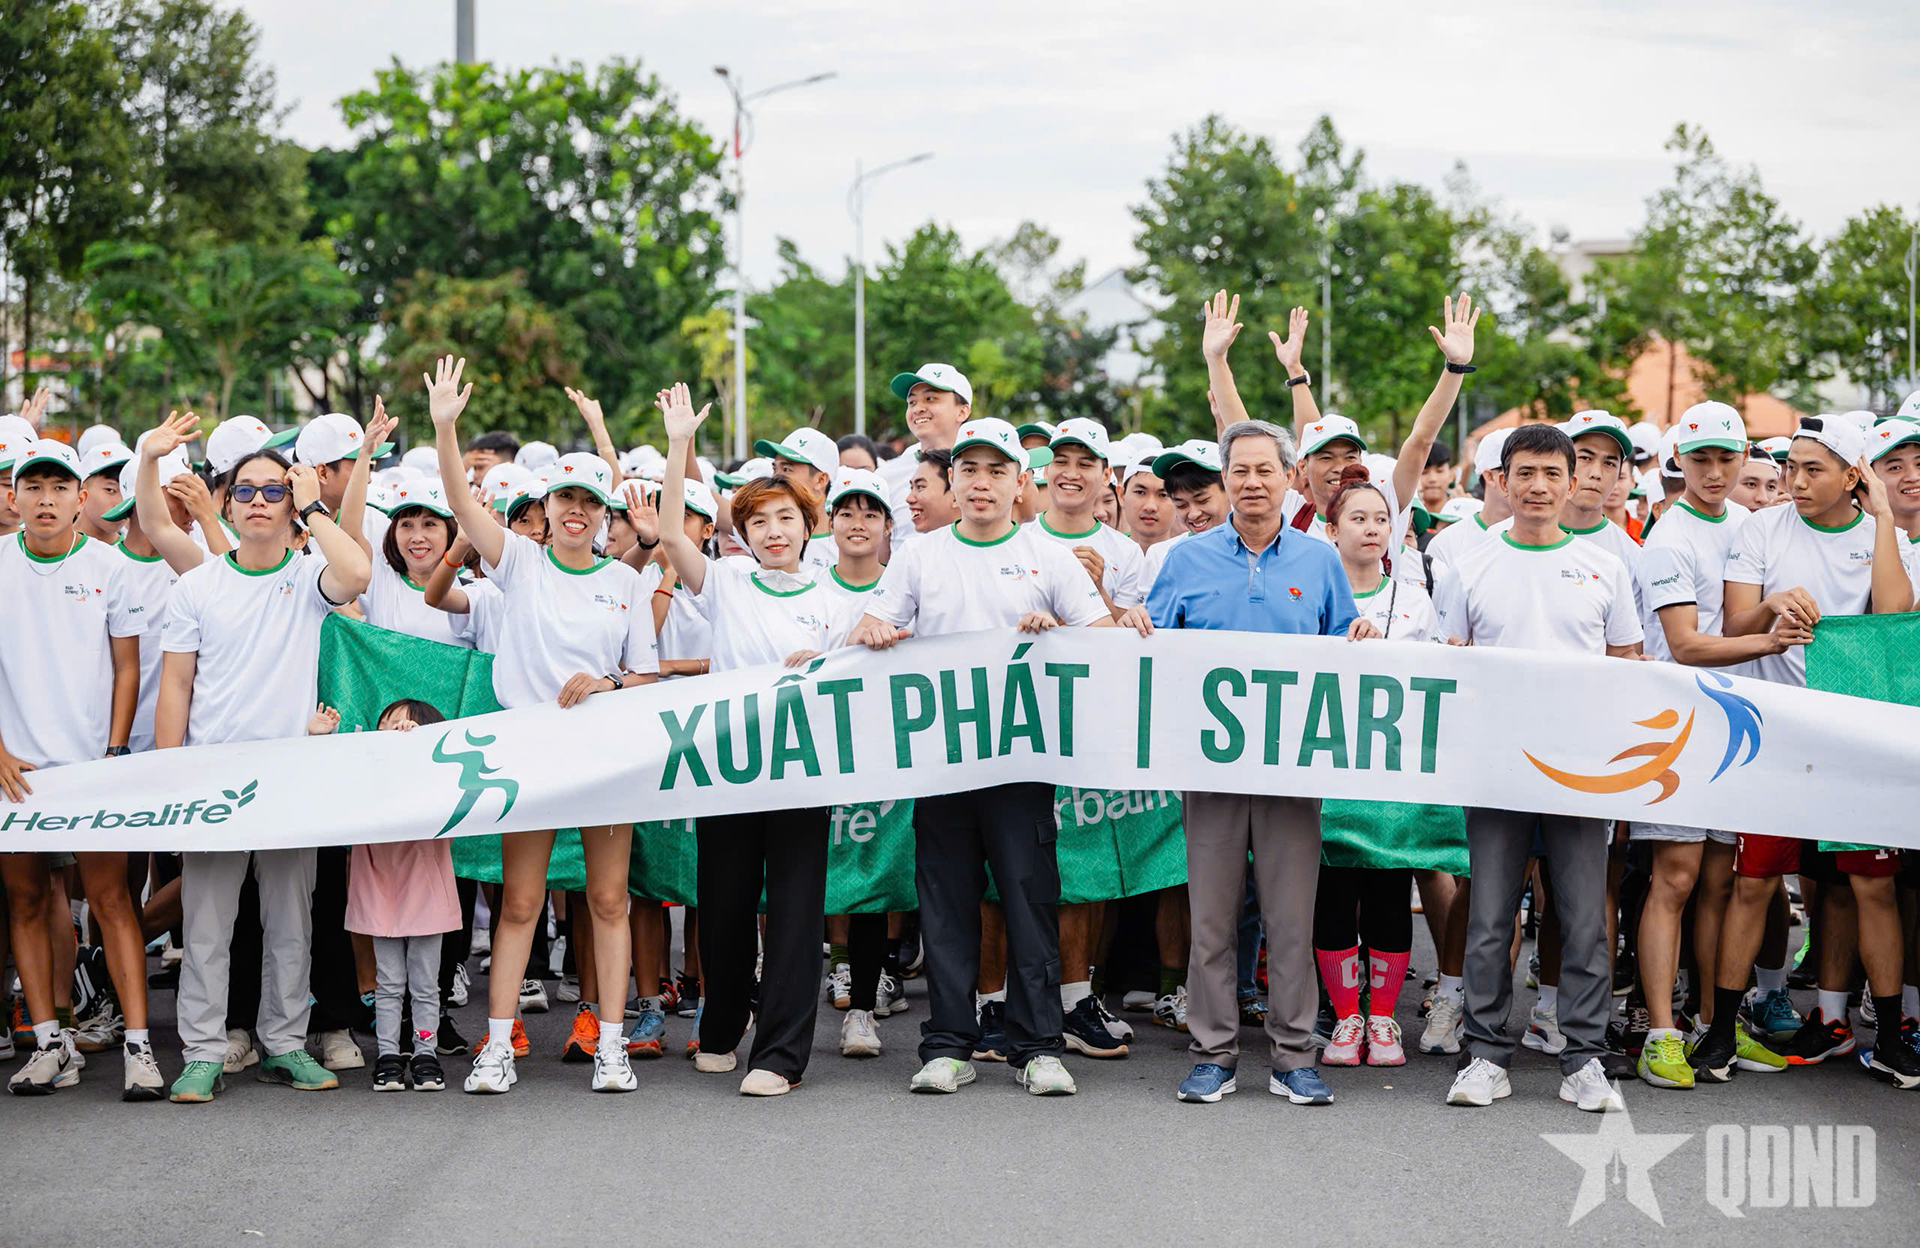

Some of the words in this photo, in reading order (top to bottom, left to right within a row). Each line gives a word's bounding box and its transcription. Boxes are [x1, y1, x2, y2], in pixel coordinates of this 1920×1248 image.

[659, 662, 864, 791] XUẤT
[889, 642, 1090, 769] PHÁT
[1200, 666, 1457, 774] START
[1, 799, 233, 832] Herbalife
